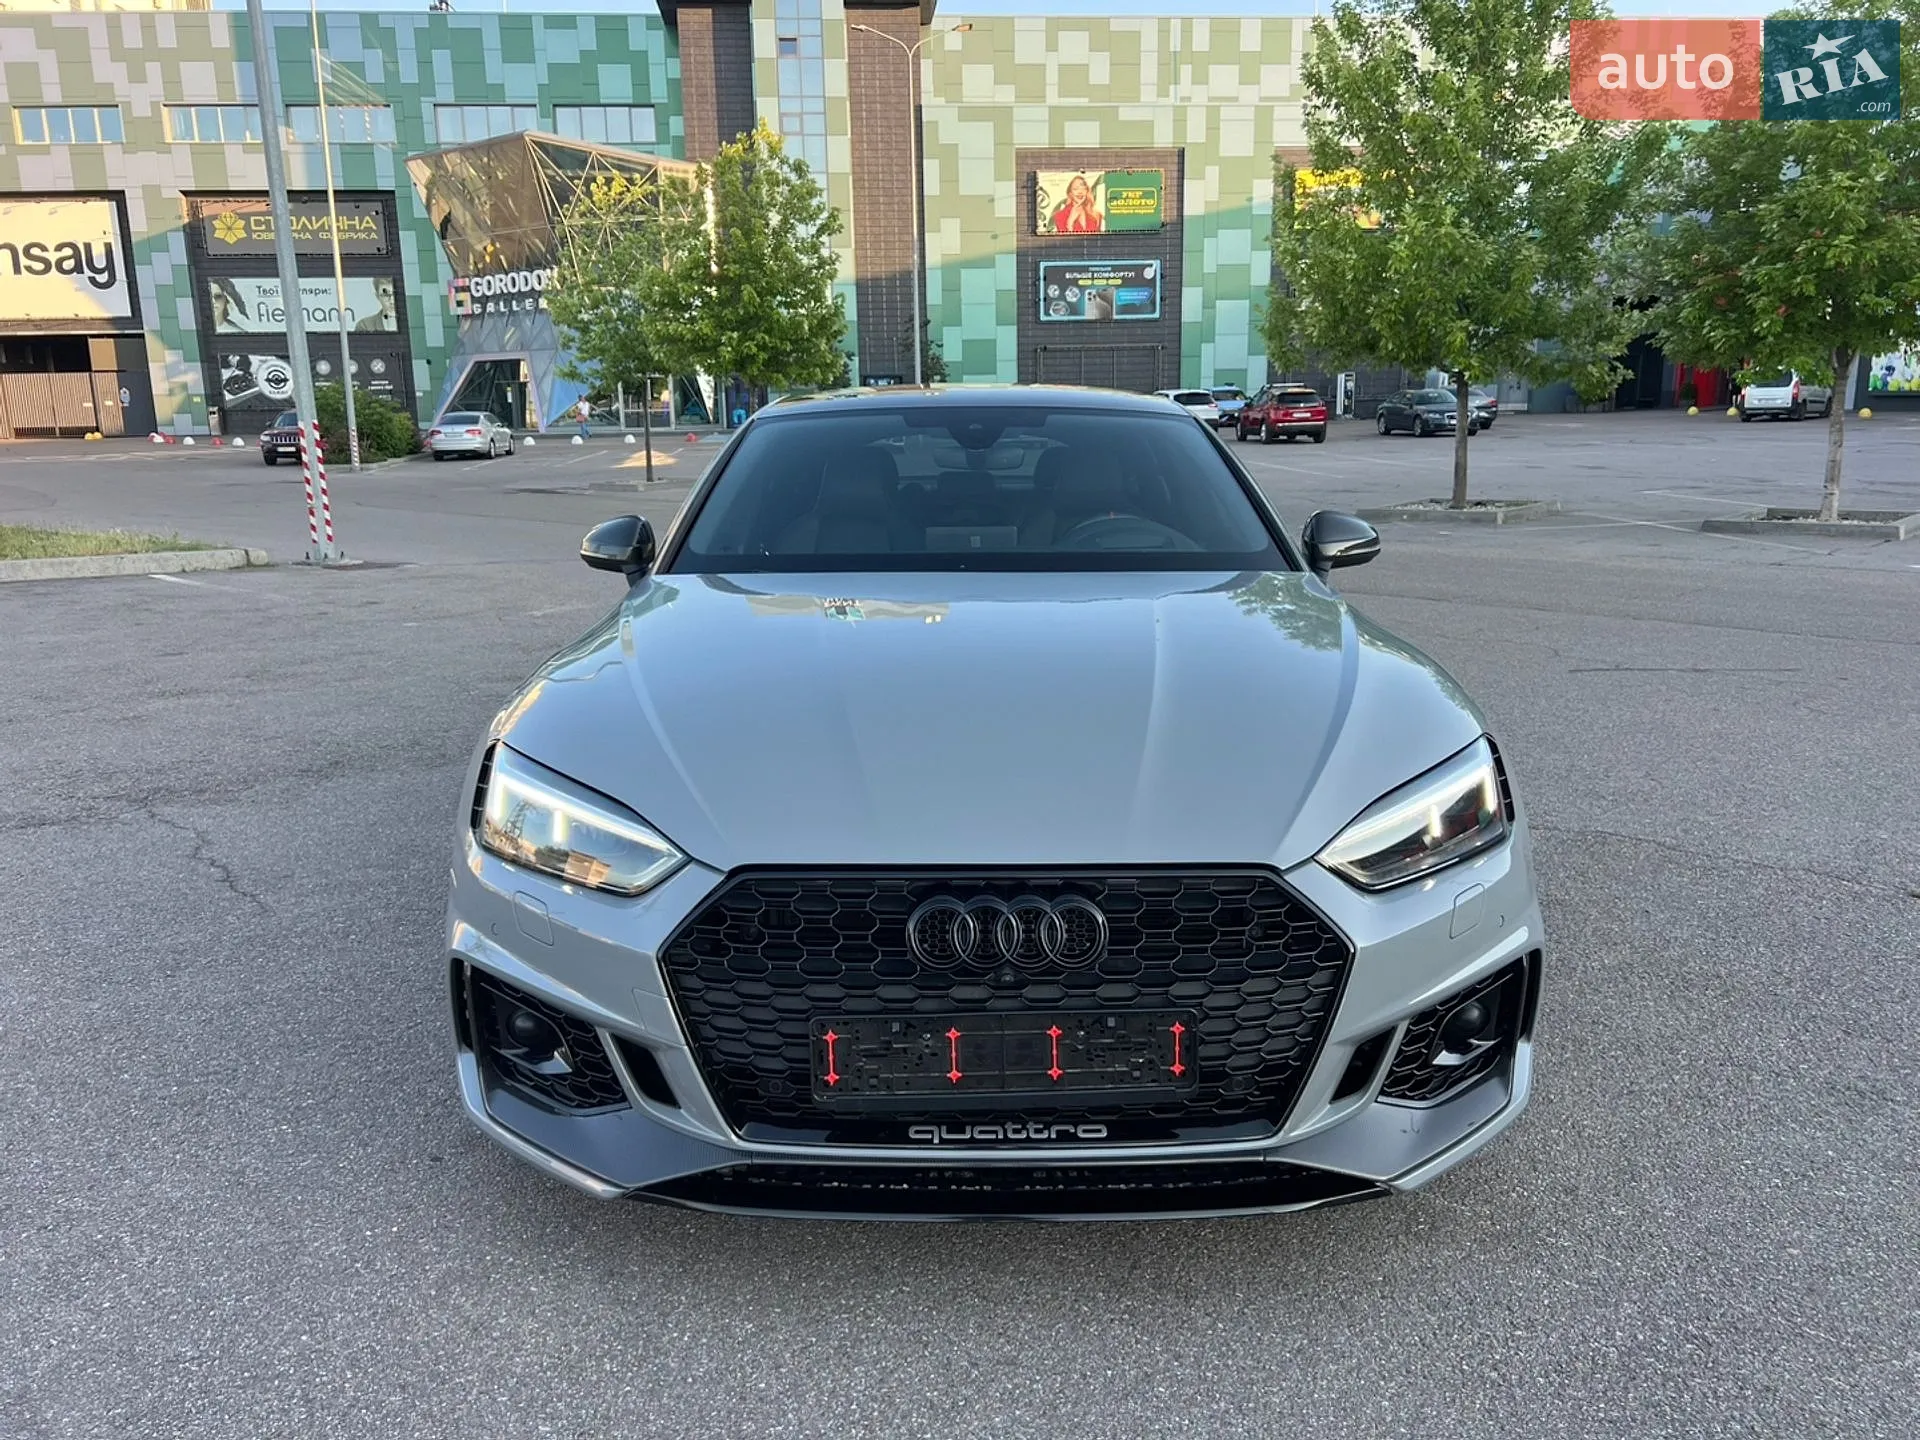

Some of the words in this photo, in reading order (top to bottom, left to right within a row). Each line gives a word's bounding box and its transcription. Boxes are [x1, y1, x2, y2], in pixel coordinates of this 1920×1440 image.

[256, 285, 279, 296] Твої
[257, 301, 355, 323] fieann
[473, 298, 548, 315] GALLER
[909, 1121, 1108, 1144] quattro
